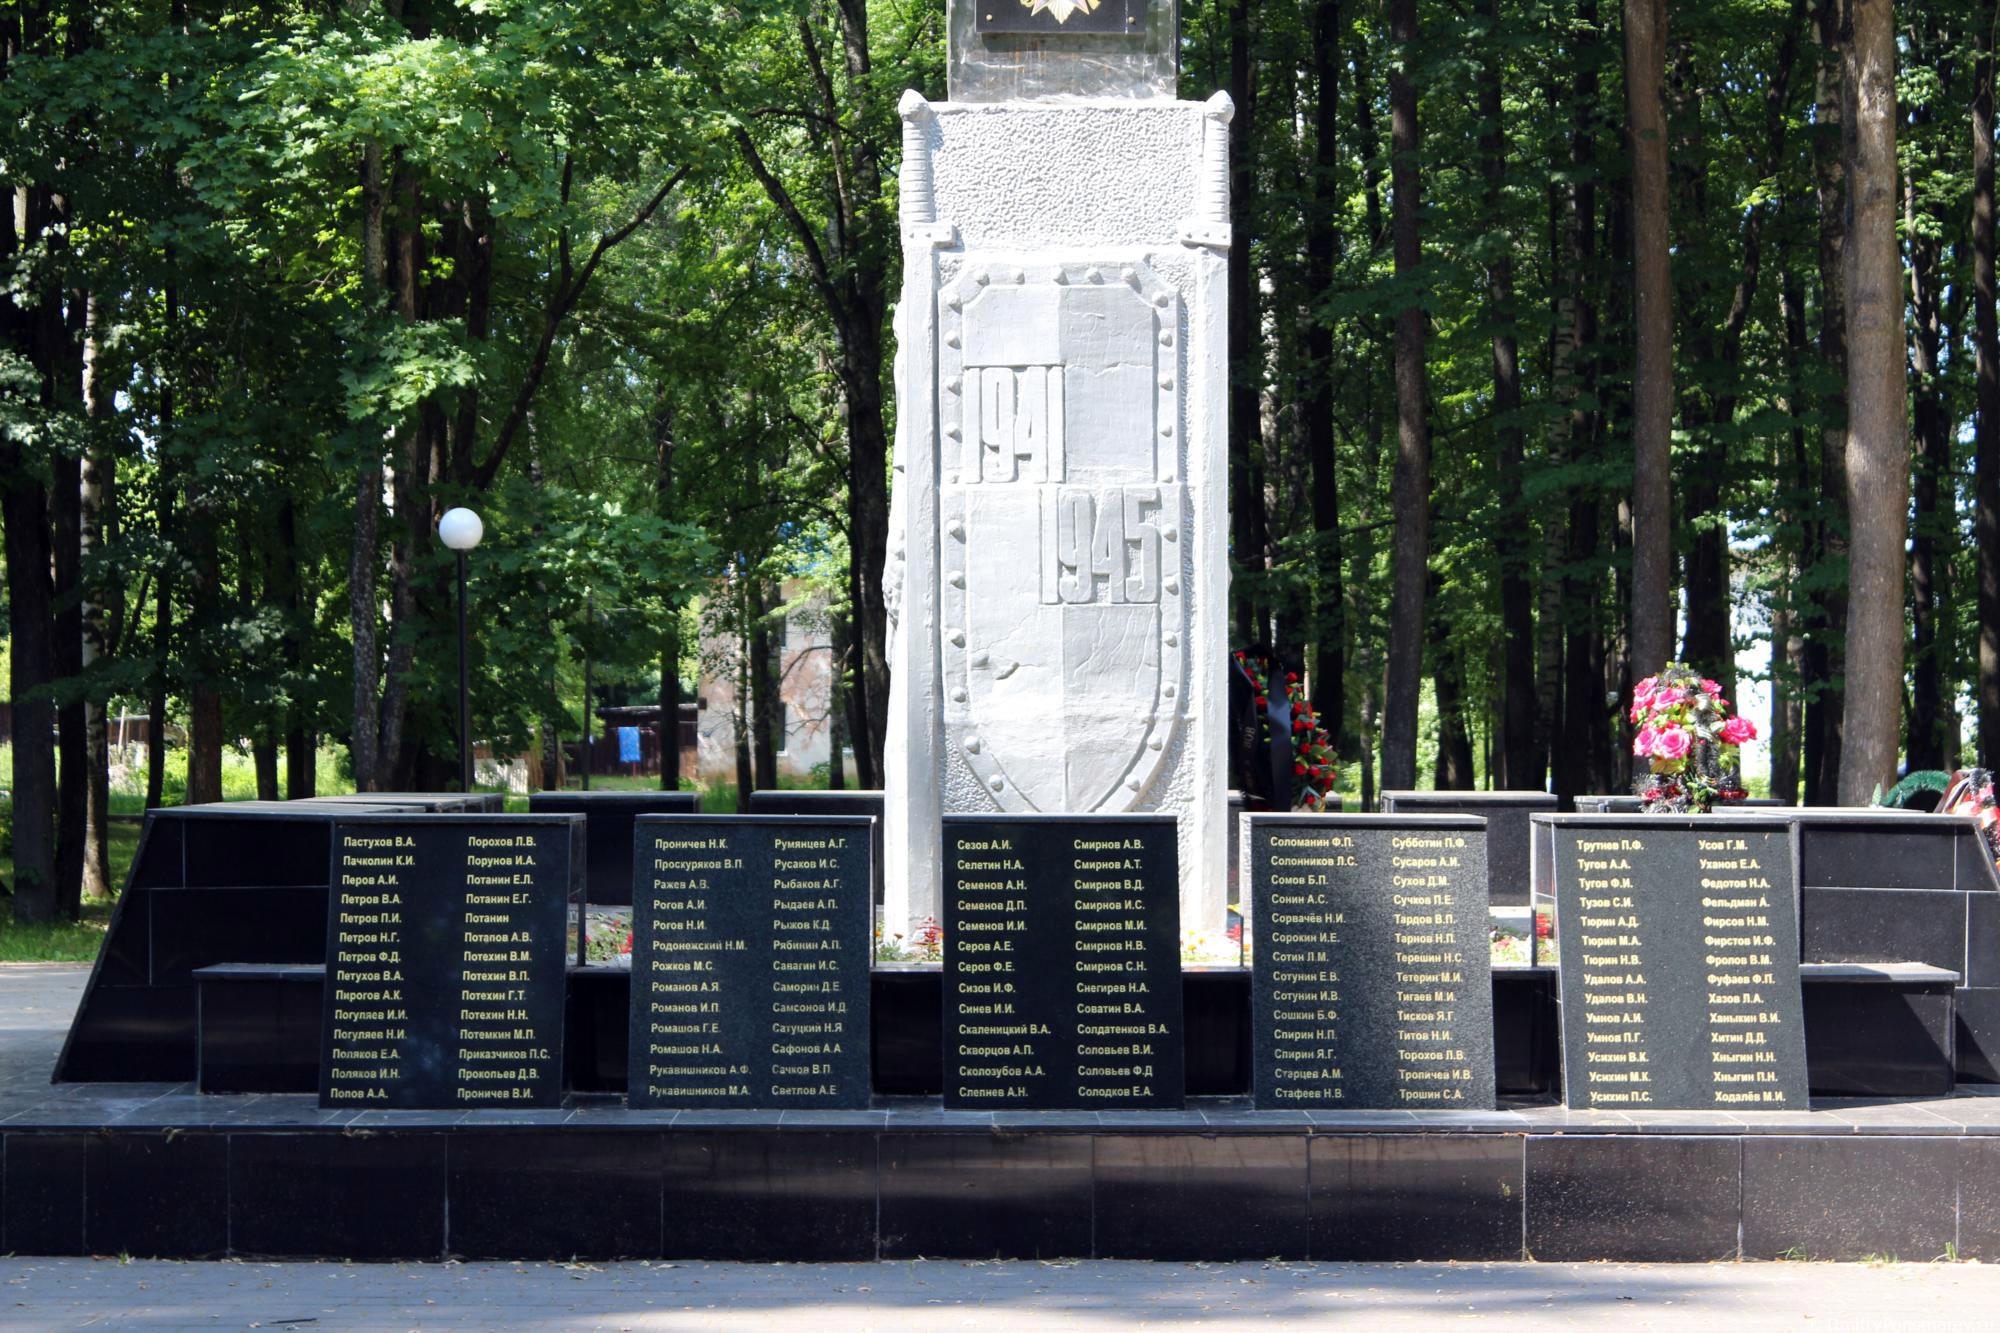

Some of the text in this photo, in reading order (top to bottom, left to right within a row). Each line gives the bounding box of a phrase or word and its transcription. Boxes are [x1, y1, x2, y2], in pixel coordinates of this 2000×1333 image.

[963, 366, 1065, 483] 1941
[1040, 487, 1160, 603] 1945
[343, 837, 417, 849] Пастухов В.А.
[467, 836, 537, 848] Порохов Л.В.
[956, 840, 1013, 851] Сезов А.И.
[1073, 839, 1144, 852] Смирнов А.В.
[1270, 837, 1330, 847] Соломанин
[1697, 840, 1725, 851] Усов
[467, 855, 537, 868] Порунов И.А.
[956, 860, 1025, 871] Селетин Н.А.
[1073, 859, 1142, 872] Смирнов А.Т.
[1576, 859, 1608, 872] Тугов
[1699, 859, 1739, 870] Уханов
[341, 875, 399, 887] Перов А.И.
[466, 874, 534, 885] Потанин Е.Л.
[1074, 879, 1145, 892] Смирнов В.Д.
[1270, 875, 1306, 885] Сомов
[1578, 878, 1609, 891] Тугов
[1700, 878, 1748, 890] Федотов
[465, 893, 532, 905] Потанин Е.Г.
[1271, 894, 1305, 904] Сонин
[1579, 897, 1611, 910] Тузов
[957, 900, 1027, 912] Семенов Д.П.
[1074, 900, 1145, 912] Смирнов И.С.
[339, 913, 402, 925] Петров П.И.
[464, 913, 510, 924] Потанин
[1271, 913, 1323, 925] Сорвачёв
[1703, 916, 1745, 929] Фирсов
[338, 932, 400, 945] Петров Н.Г.
[463, 932, 533, 943] Потапов А.В.
[1271, 932, 1318, 945] Сорокин
[1581, 936, 1617, 948] Тюрин
[957, 941, 1014, 954] Серов А.Е.
[1074, 940, 1147, 953] Смирнов Н.В.
[1705, 955, 1748, 967] Фролов
[336, 970, 405, 984] Петухов В.А.
[462, 971, 530, 982] Потехин В.П.
[1272, 971, 1318, 984] Сотунин
[1583, 974, 1624, 986] Удалов
[958, 983, 1016, 994] Сизов И.Ф.
[1076, 983, 1150, 995] Снегирев Н.А.
[335, 990, 403, 1003] Пирогов А.К.
[1272, 991, 1318, 1003] Сотунин
[1584, 993, 1625, 1006] Удалов
[1708, 993, 1741, 1004] Хазов
[958, 1004, 1015, 1014] Синев И.И.
[1076, 1003, 1145, 1014] Соватин В.А.
[334, 1009, 409, 1022] Погуляев И.И.
[1585, 1013, 1621, 1024] Умнов
[1709, 1013, 1758, 1024] Ханыкин
[958, 1024, 1051, 1036] Скаленицкий В.А.
[1147, 1024, 1169, 1034] В.А.
[1710, 1032, 1744, 1043] Хитин
[529, 1049, 551, 1060] П.С.
[958, 1045, 1035, 1057] Скворцов А.П.
[1077, 1044, 1154, 1056] Соловьев В.И.
[1274, 1068, 1320, 1081] Старцев
[330, 1088, 389, 1099] Попов А.А.
[958, 1087, 1029, 1098] Слепнев А.Н.
[1589, 1092, 1629, 1102] Усихин
